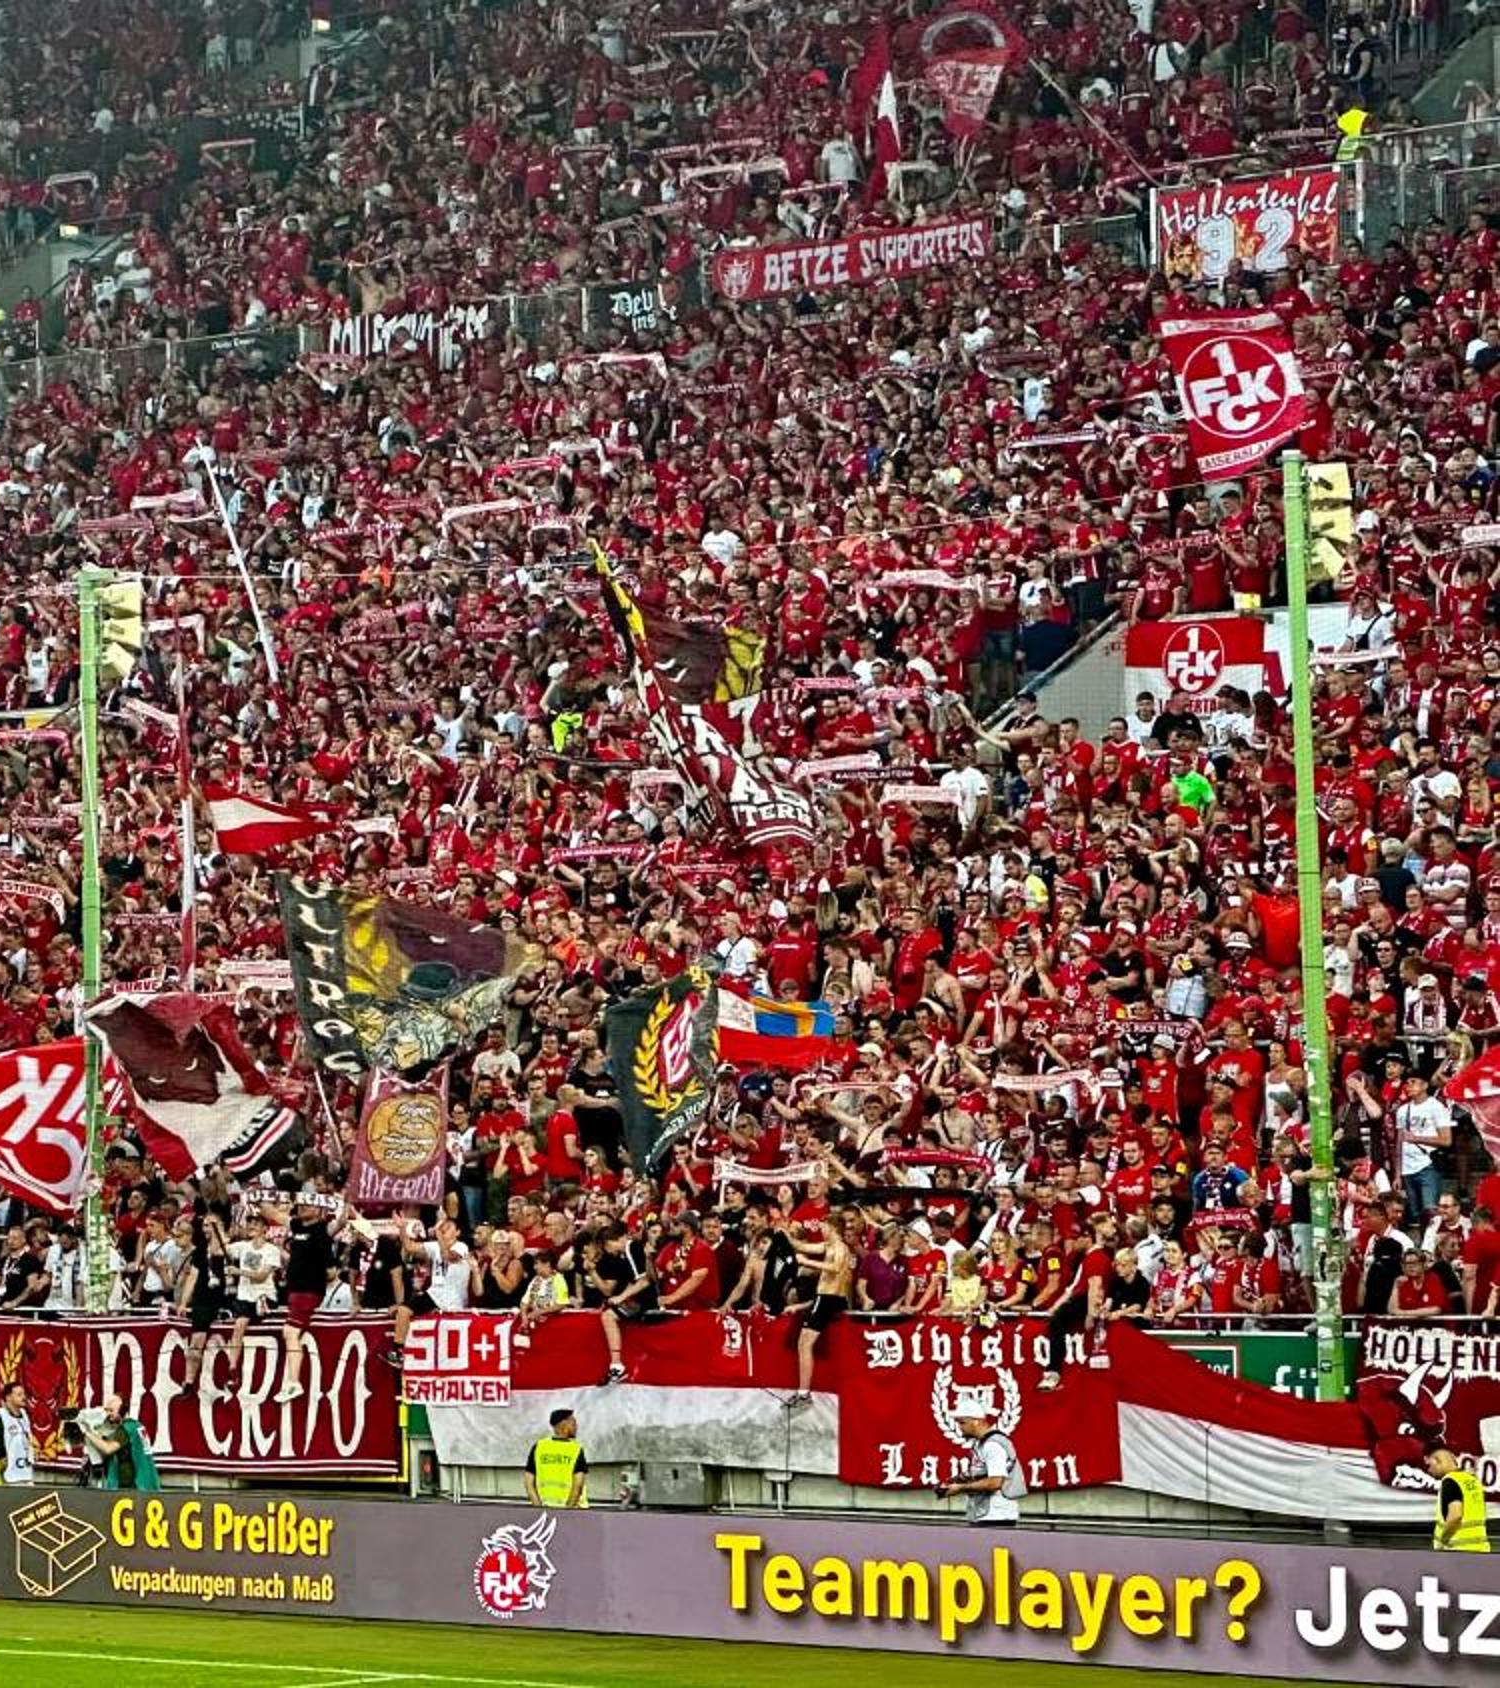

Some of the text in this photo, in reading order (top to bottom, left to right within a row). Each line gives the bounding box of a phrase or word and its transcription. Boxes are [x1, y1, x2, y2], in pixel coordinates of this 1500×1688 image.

[763, 220, 984, 291] BETZE SUPPORTERS
[403, 1319, 514, 1371] 50+1
[1370, 1326, 1500, 1372] HÖLLEN
[405, 1379, 509, 1401] ERHALTEN
[879, 1441, 1080, 1487] Laurn
[110, 1498, 333, 1556] G & G Preißer
[110, 1565, 334, 1602] Verpackungen nach Maß
[715, 1533, 1263, 1653] Teamplayer?
